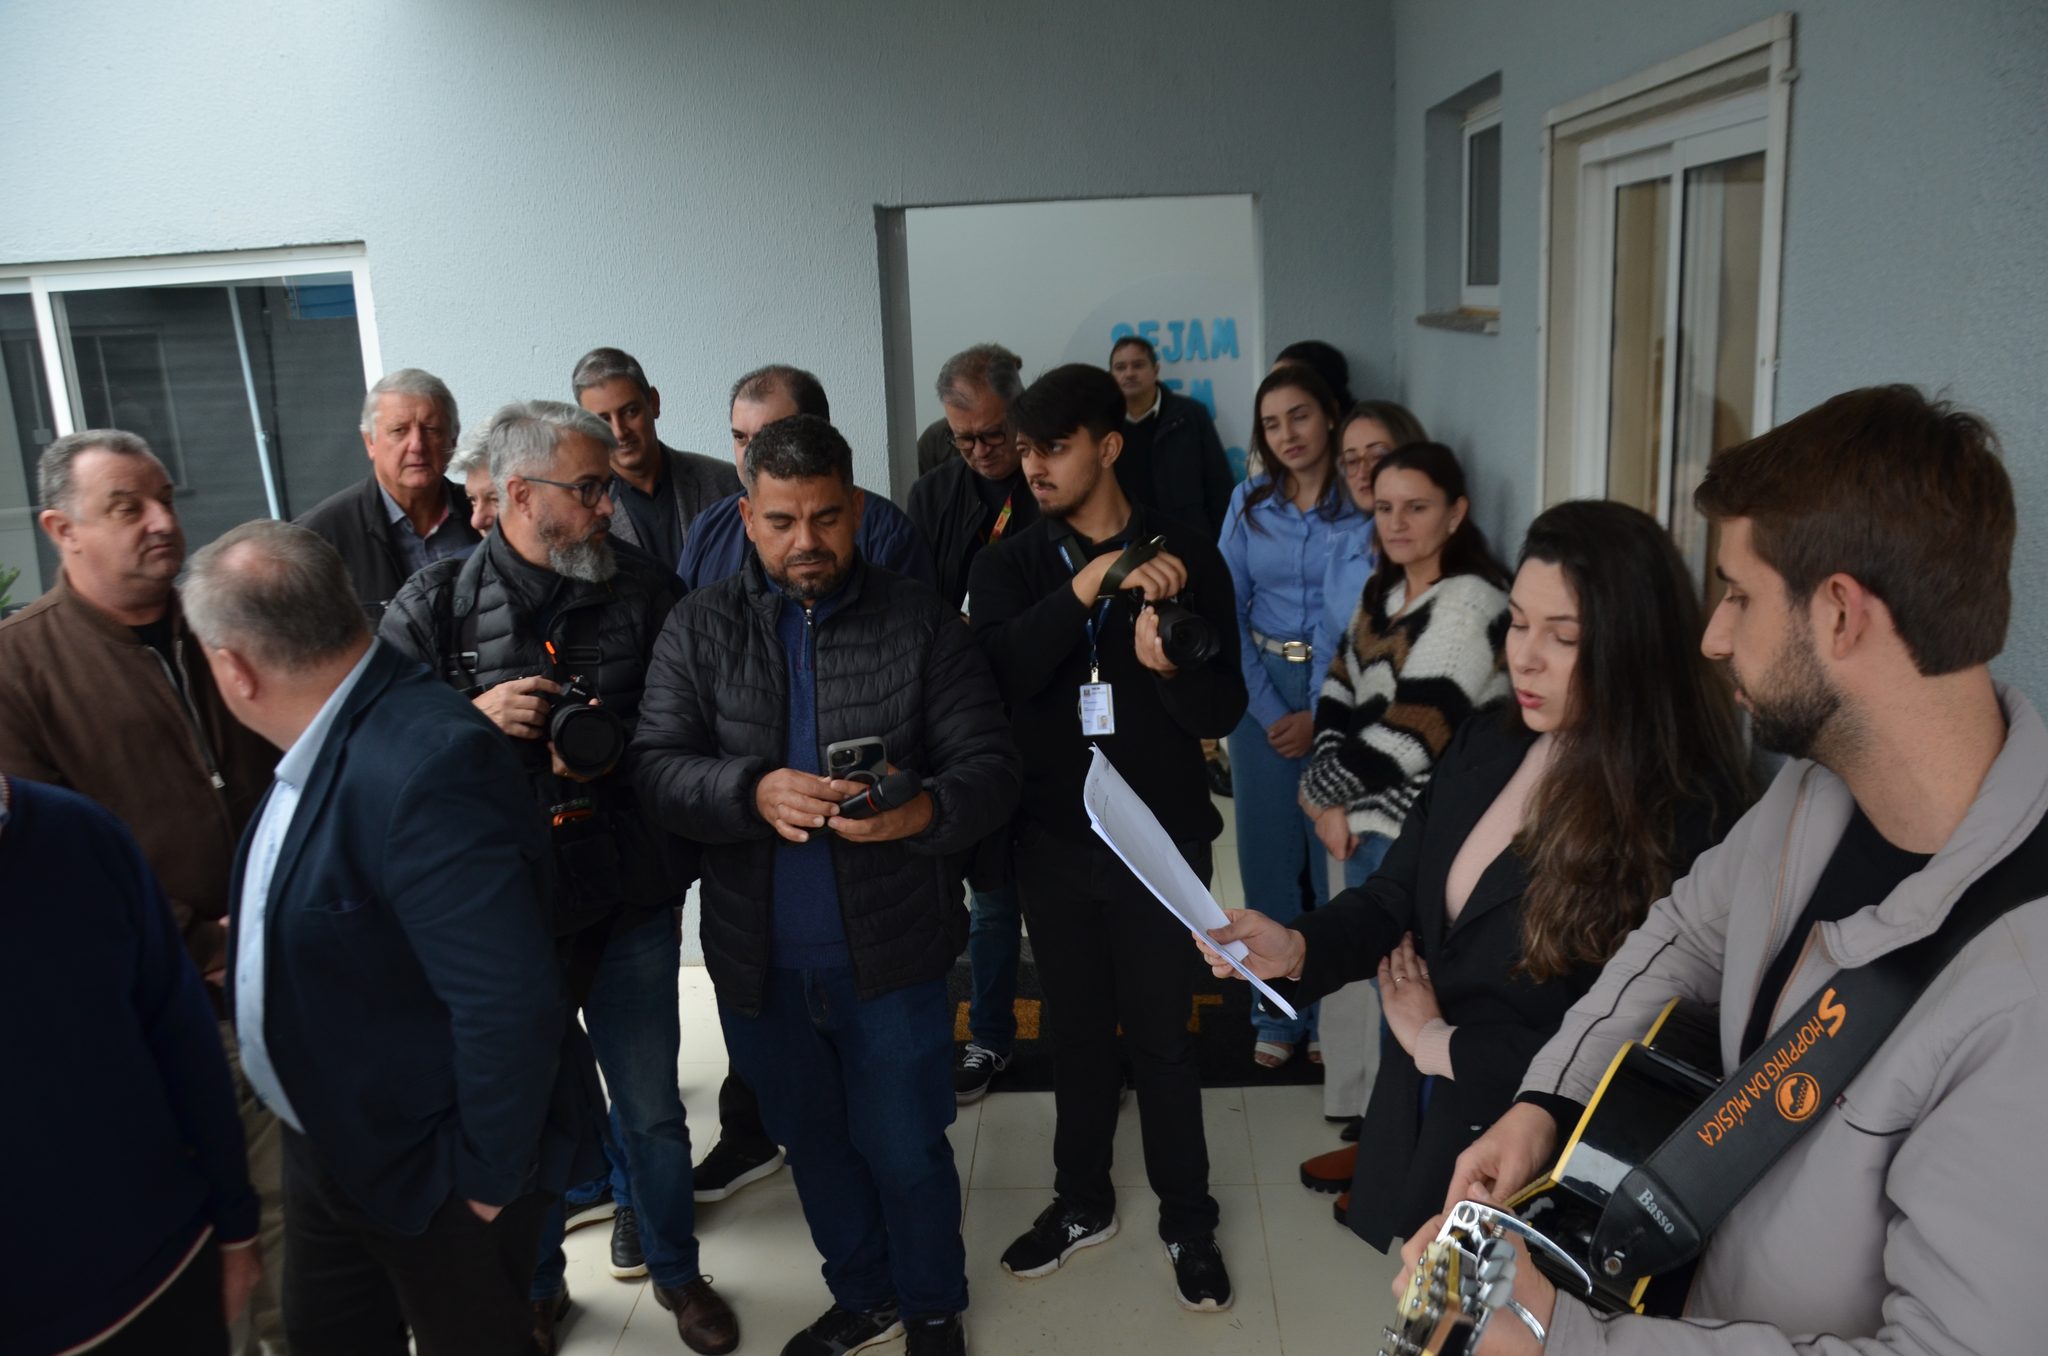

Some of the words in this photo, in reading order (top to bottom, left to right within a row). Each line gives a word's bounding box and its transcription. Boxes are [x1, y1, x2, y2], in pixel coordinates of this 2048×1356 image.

[1763, 986, 1847, 1082] SHOPPING
[1744, 1071, 1772, 1099] DA
[1696, 1089, 1752, 1147] MÚSICA
[1635, 1187, 1675, 1235] Basso
